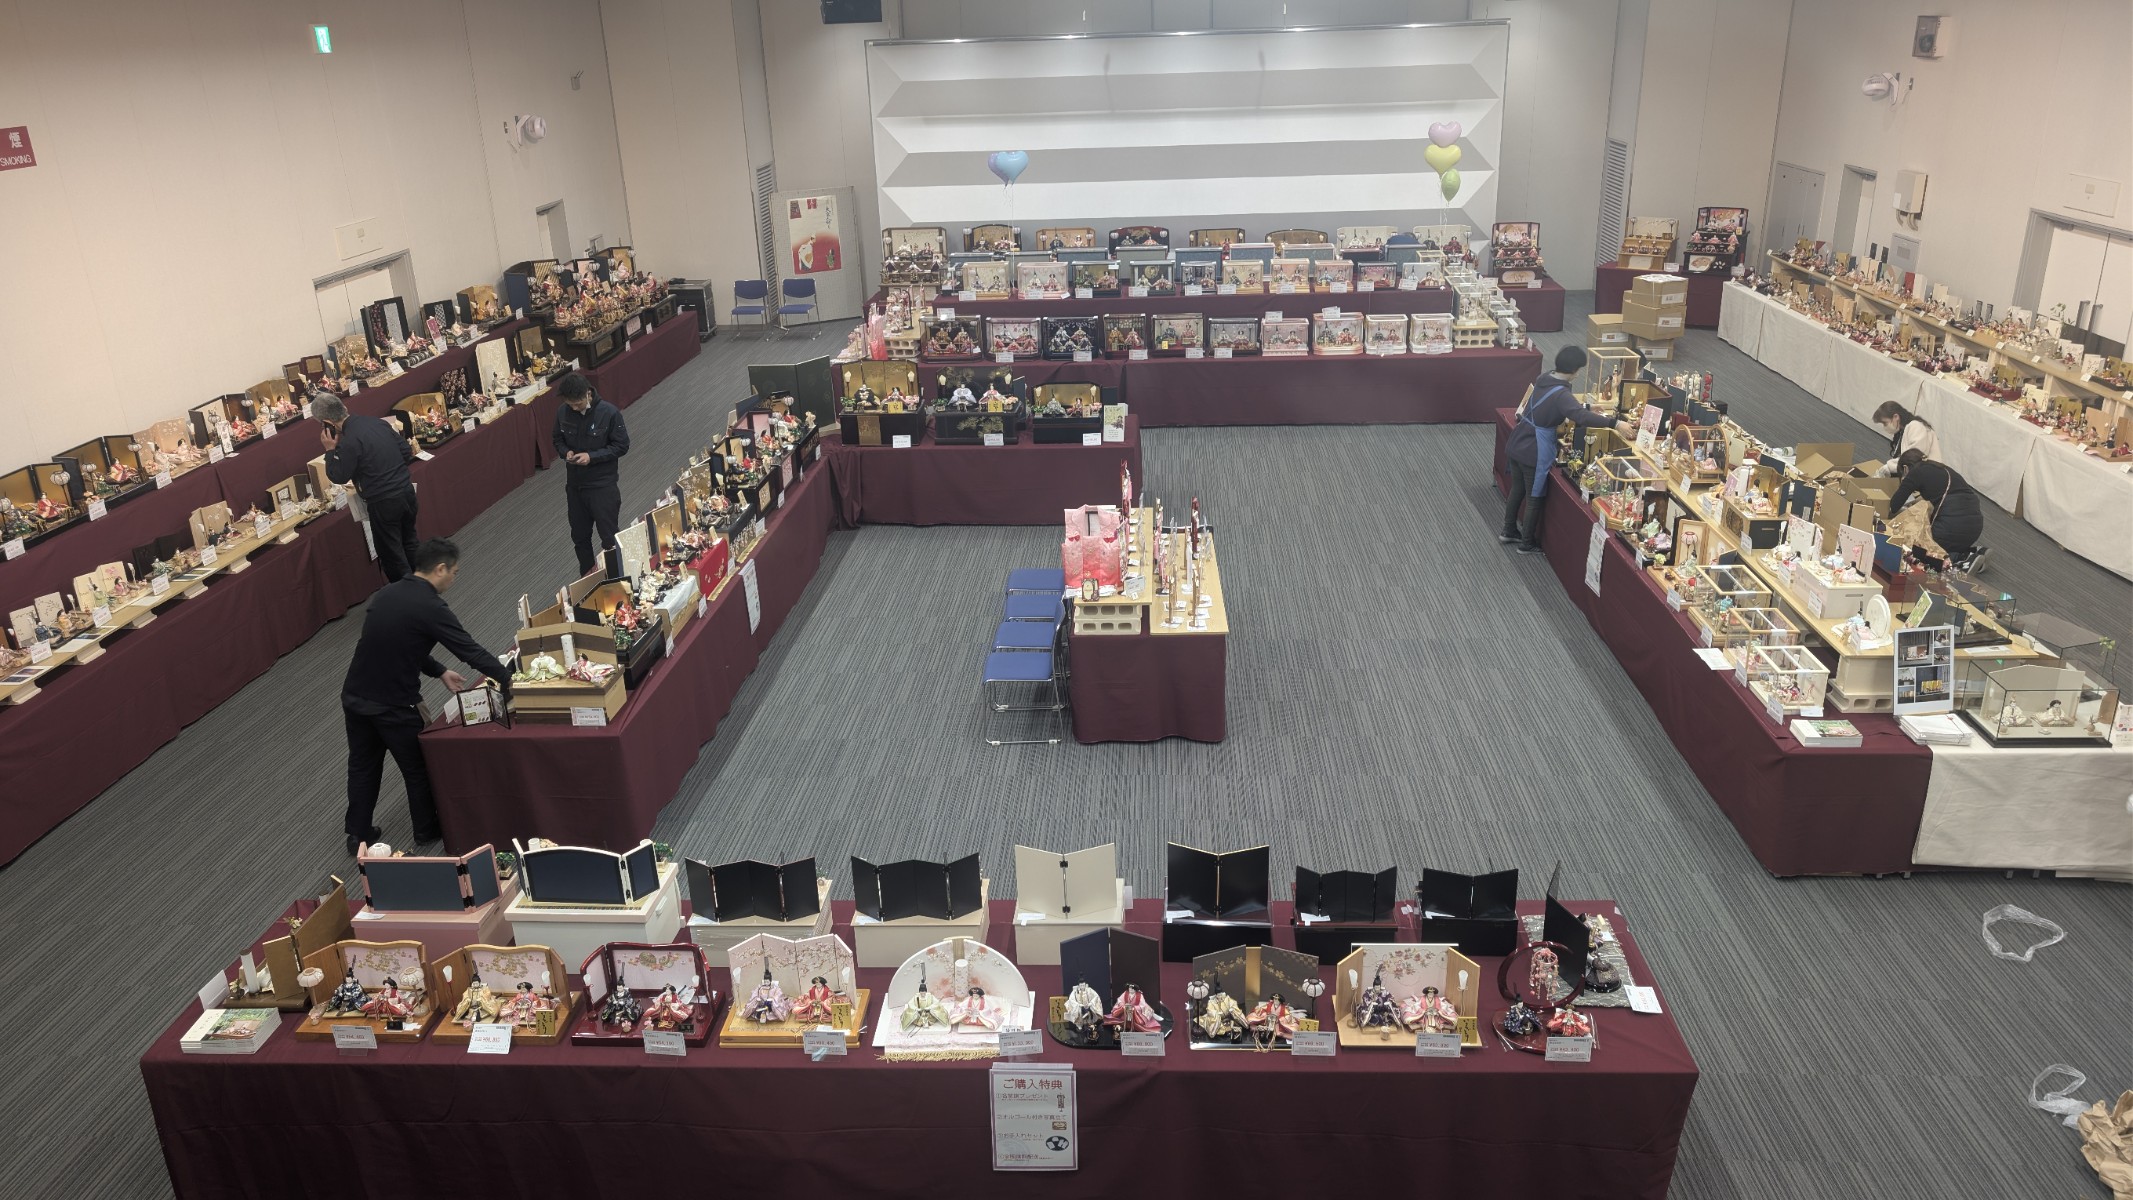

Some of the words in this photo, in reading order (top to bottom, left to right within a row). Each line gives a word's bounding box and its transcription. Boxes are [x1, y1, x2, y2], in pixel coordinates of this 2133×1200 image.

[0, 154, 32, 167] SMOKING
[1003, 1078, 1063, 1090] ご購入特典
